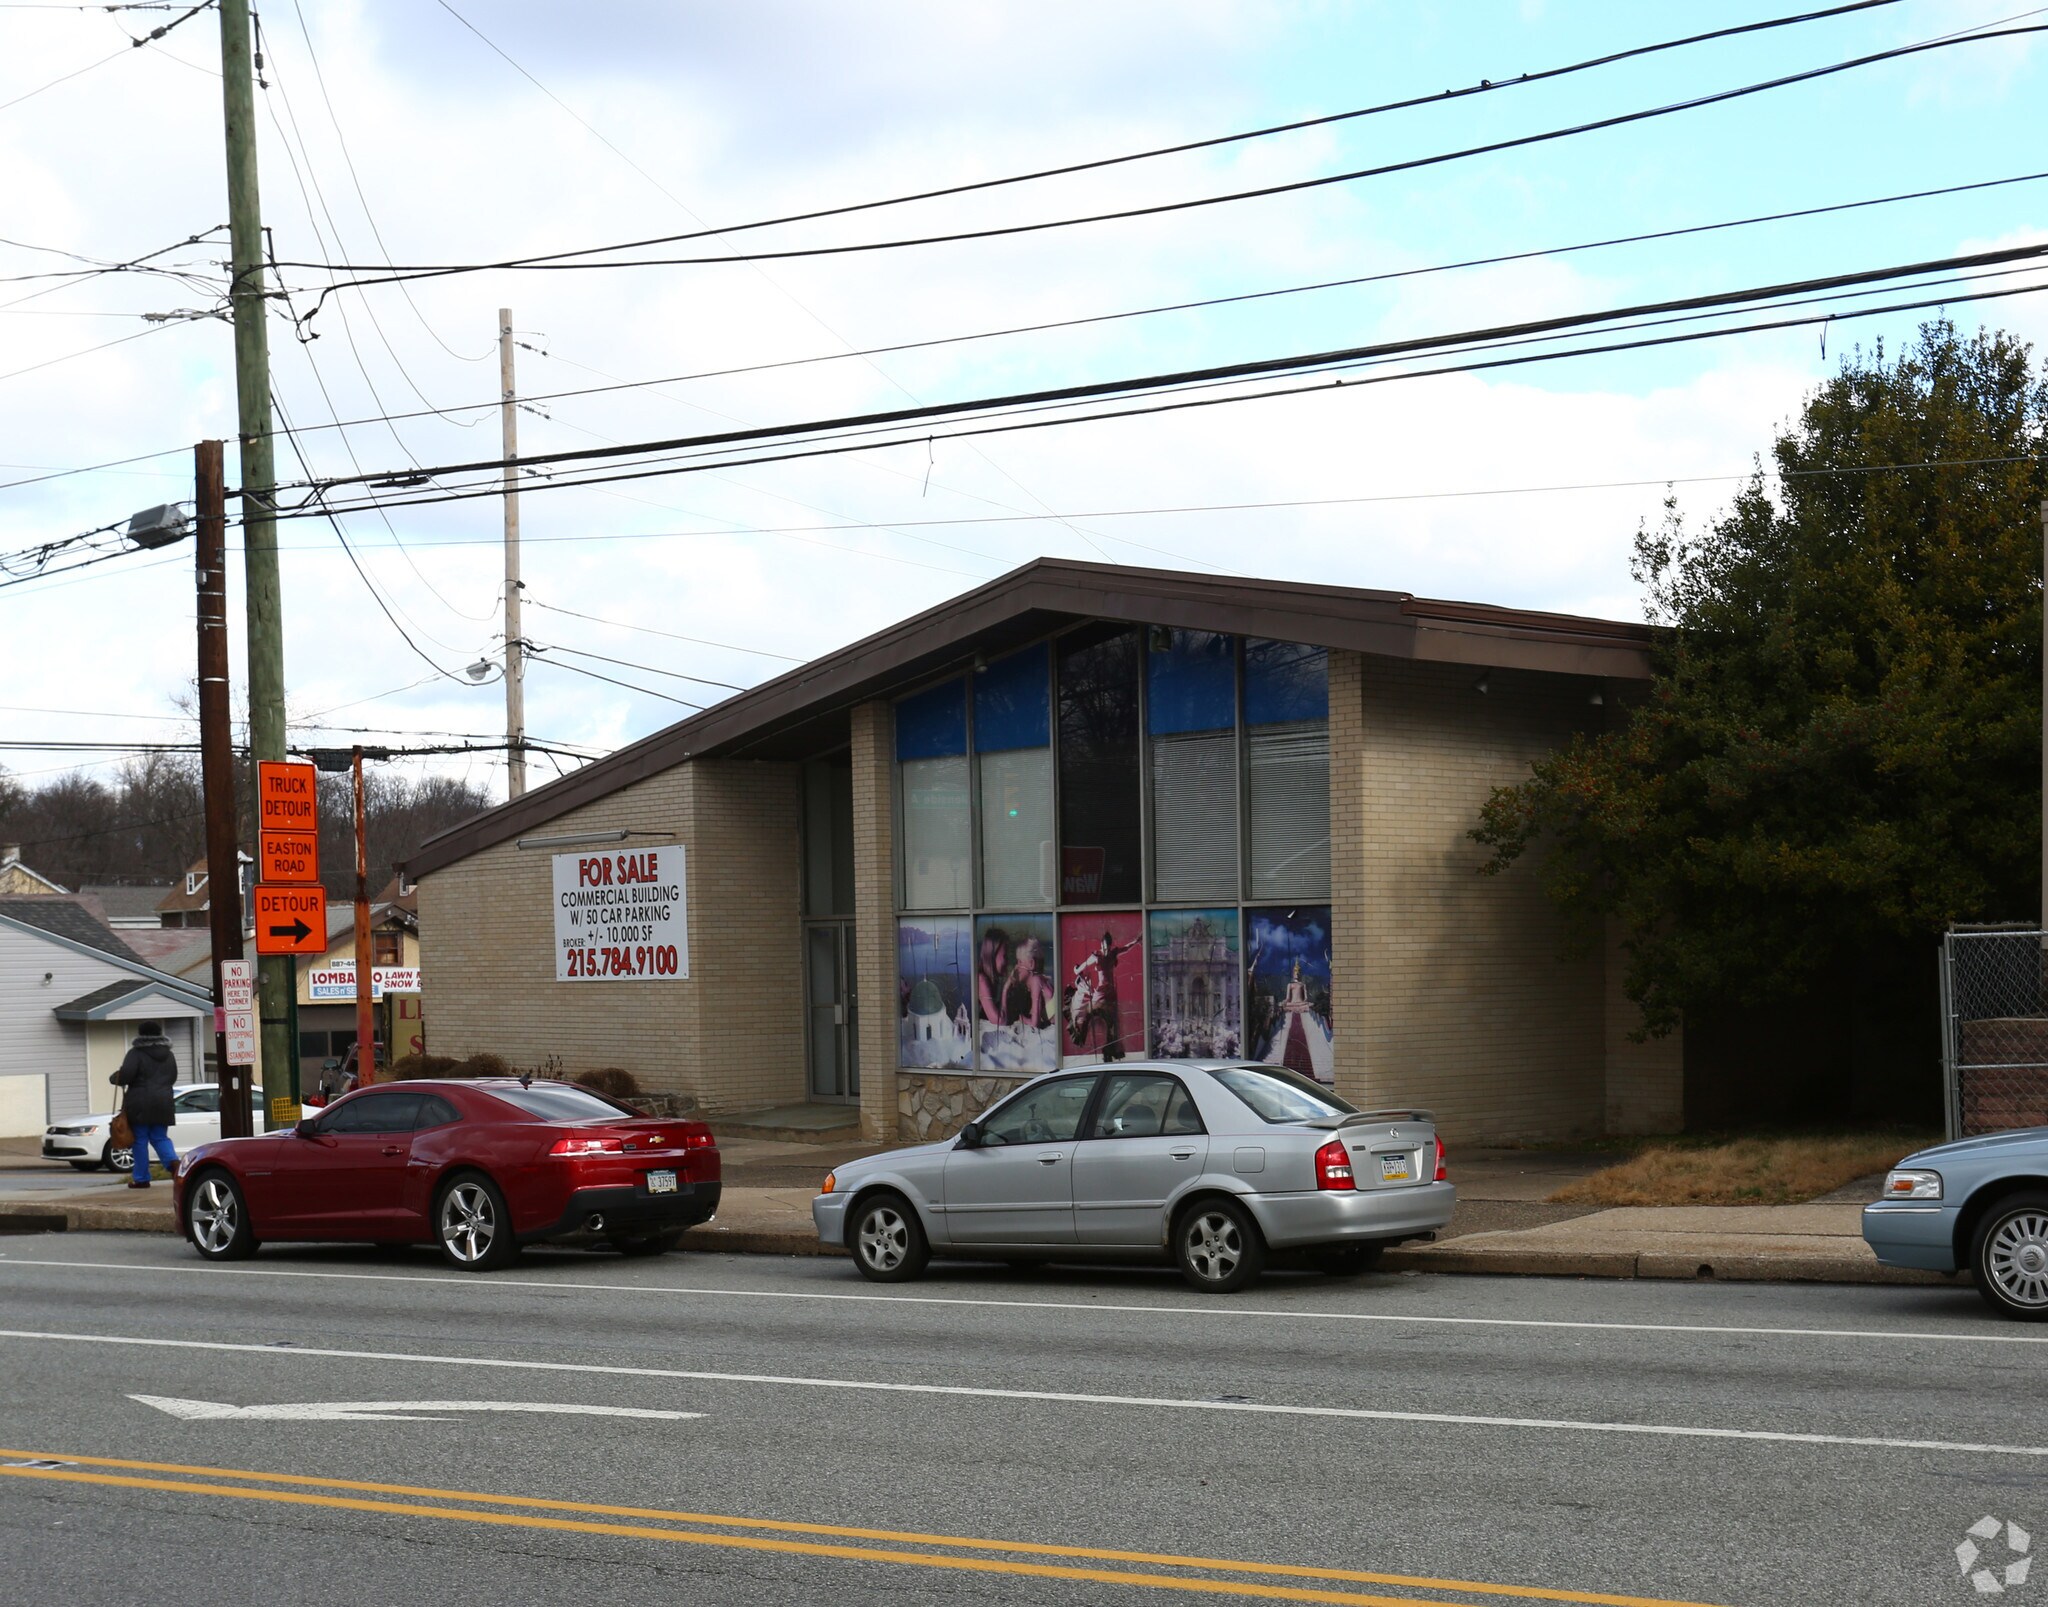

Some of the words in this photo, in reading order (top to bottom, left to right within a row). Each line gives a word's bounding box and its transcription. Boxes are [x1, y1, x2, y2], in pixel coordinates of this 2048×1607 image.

[269, 777, 307, 794] TRUCK
[265, 800, 311, 817] DETOUR
[267, 842, 312, 856] EASTON
[274, 859, 306, 873] ROAD
[579, 858, 613, 887] FOR
[617, 853, 658, 885] SALE
[261, 896, 319, 912] DETOUR
[561, 888, 629, 908] COMMERCIAL
[632, 885, 680, 904] BUILDING
[570, 910, 584, 927] W/
[586, 909, 598, 925] 50
[600, 907, 622, 924] CAR
[625, 905, 671, 922] PARKING
[606, 926, 639, 944] 10,000
[641, 925, 653, 941] SF
[567, 945, 678, 977] 215.784.9100
[231, 967, 242, 976] NO
[312, 971, 383, 984] LOMBAO
[385, 971, 413, 979] LAWN
[224, 979, 251, 988] PARKING
[384, 980, 413, 988] SNOW
[233, 1018, 246, 1028] NO
